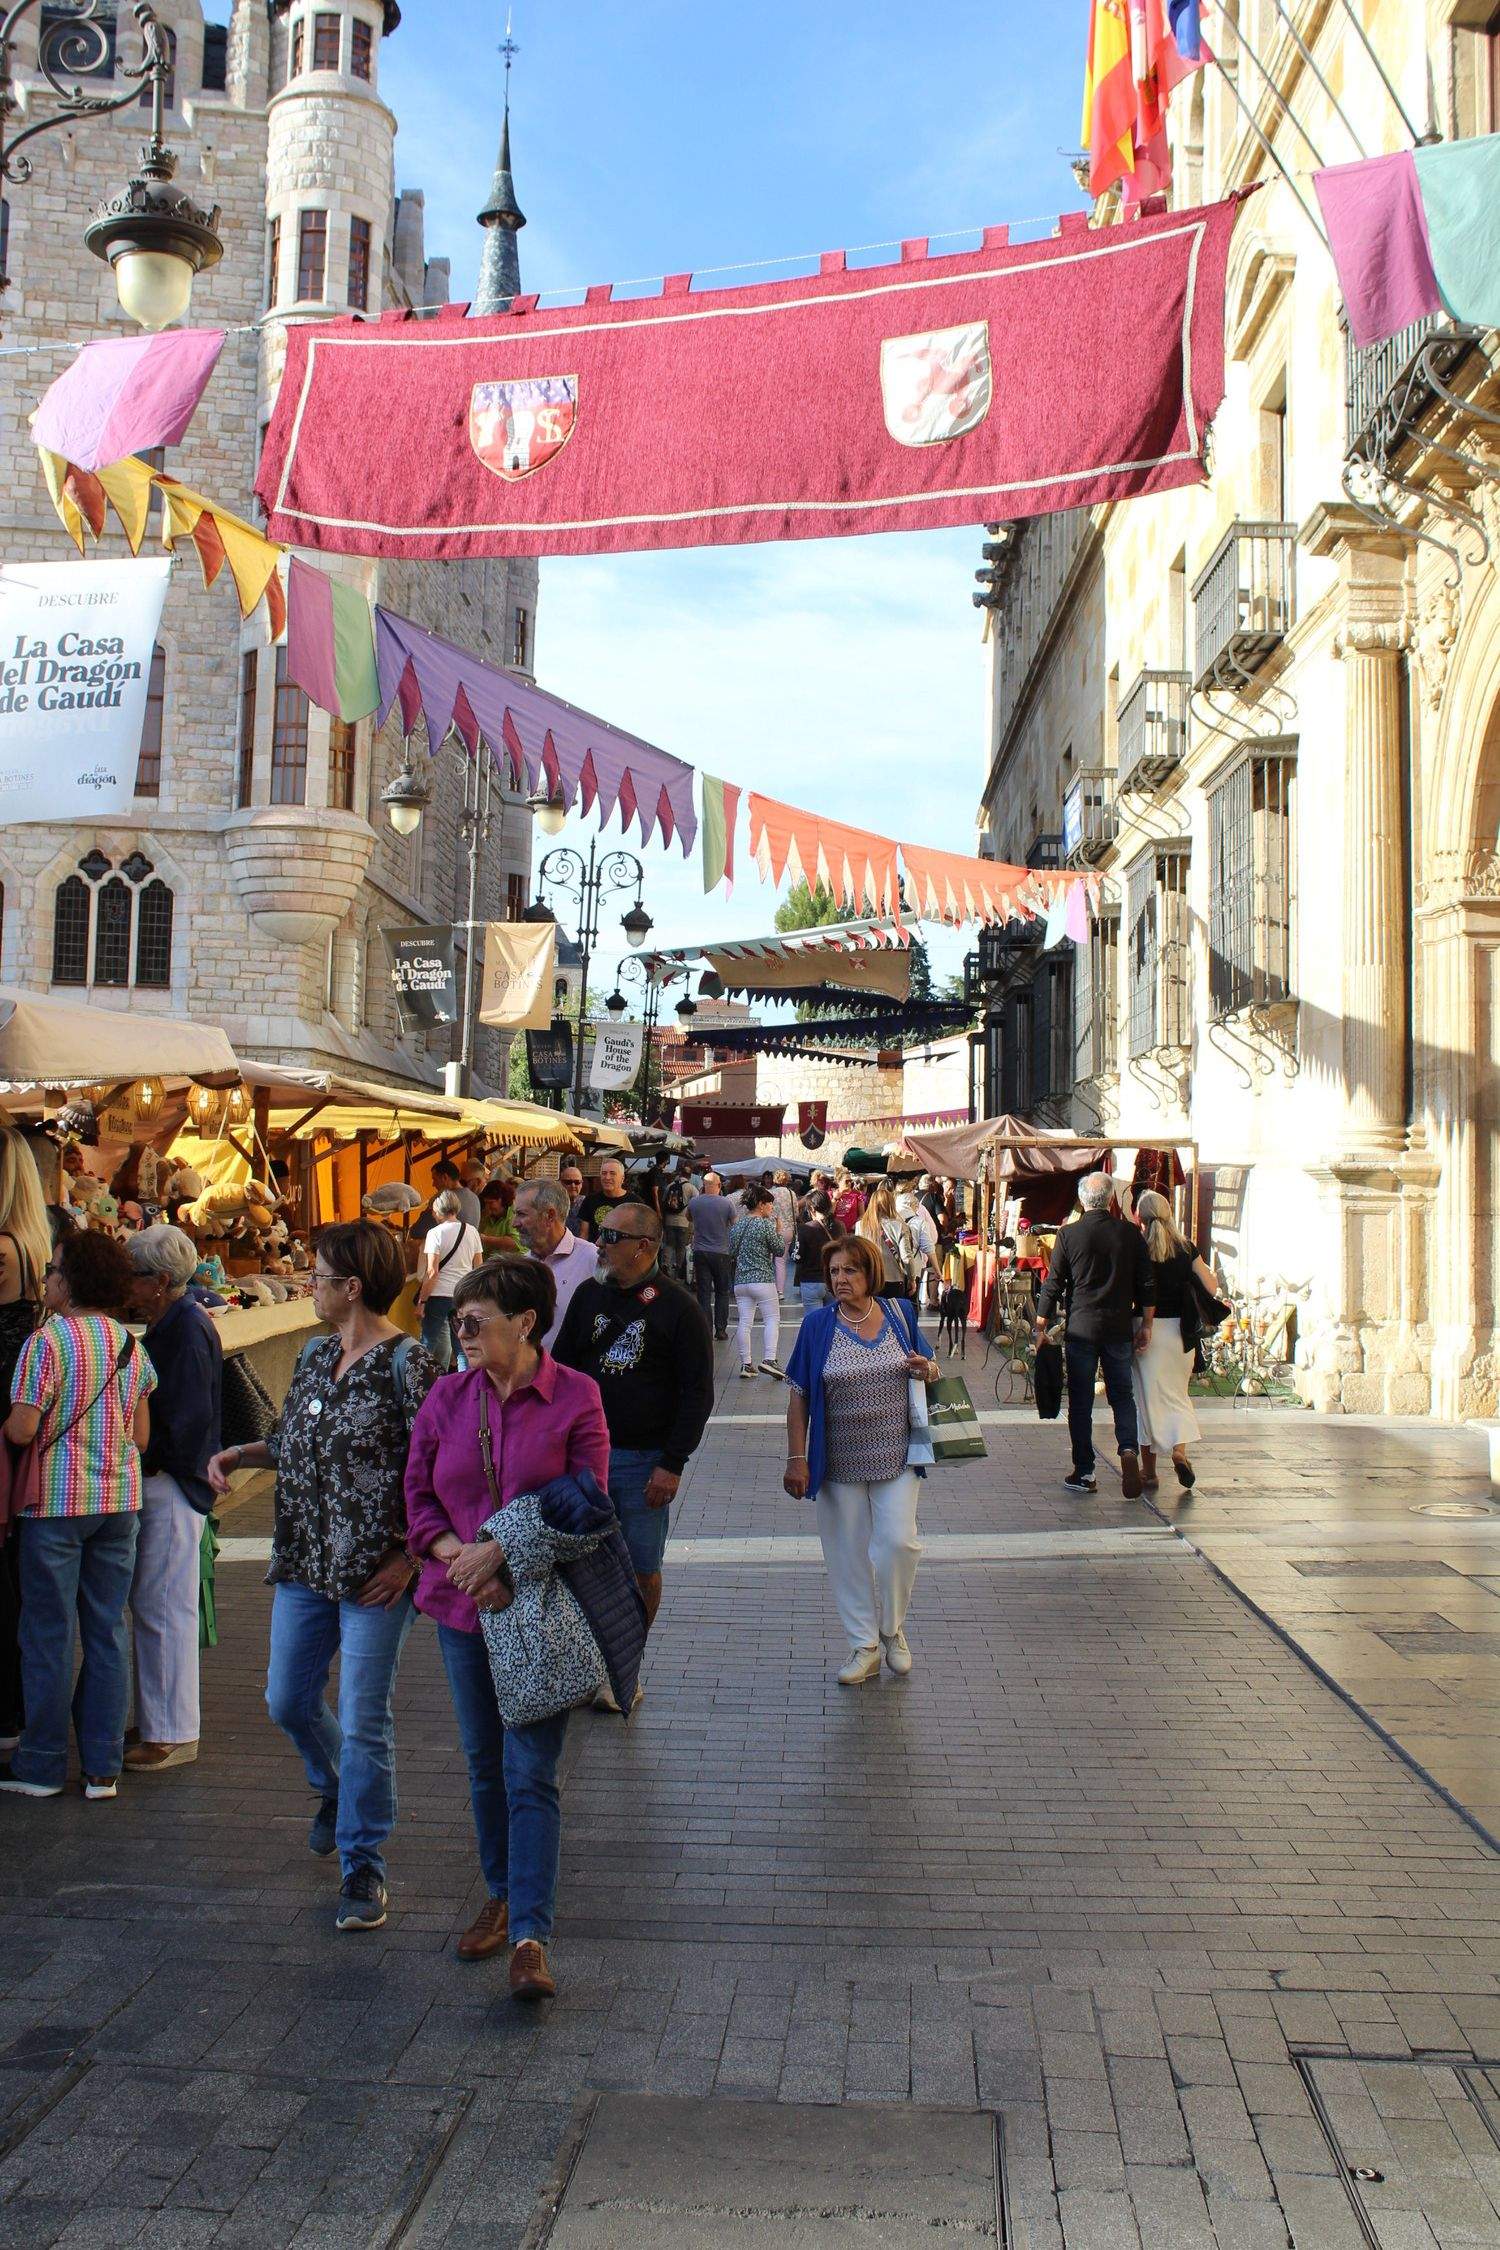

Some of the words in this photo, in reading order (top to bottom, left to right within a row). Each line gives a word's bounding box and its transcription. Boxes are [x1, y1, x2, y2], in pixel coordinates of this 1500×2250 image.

[38, 592, 119, 607] DESCUBRE
[13, 635, 48, 659] La
[57, 632, 124, 656] Casa
[35, 655, 142, 687] Dragón
[0, 686, 29, 714] de
[37, 681, 125, 711] Gaudí
[395, 958, 411, 969] La
[413, 957, 442, 969] Casa
[391, 968, 405, 981] del
[408, 967, 452, 982] Dragón
[396, 979, 408, 991] de
[410, 977, 446, 990] Gaudí
[494, 979, 543, 990] BOTINS
[605, 1045, 632, 1056] House
[532, 1056, 567, 1064] BOTINES
[605, 1053, 614, 1063] of
[616, 1055, 630, 1064] the
[600, 1061, 632, 1072] Dragon
